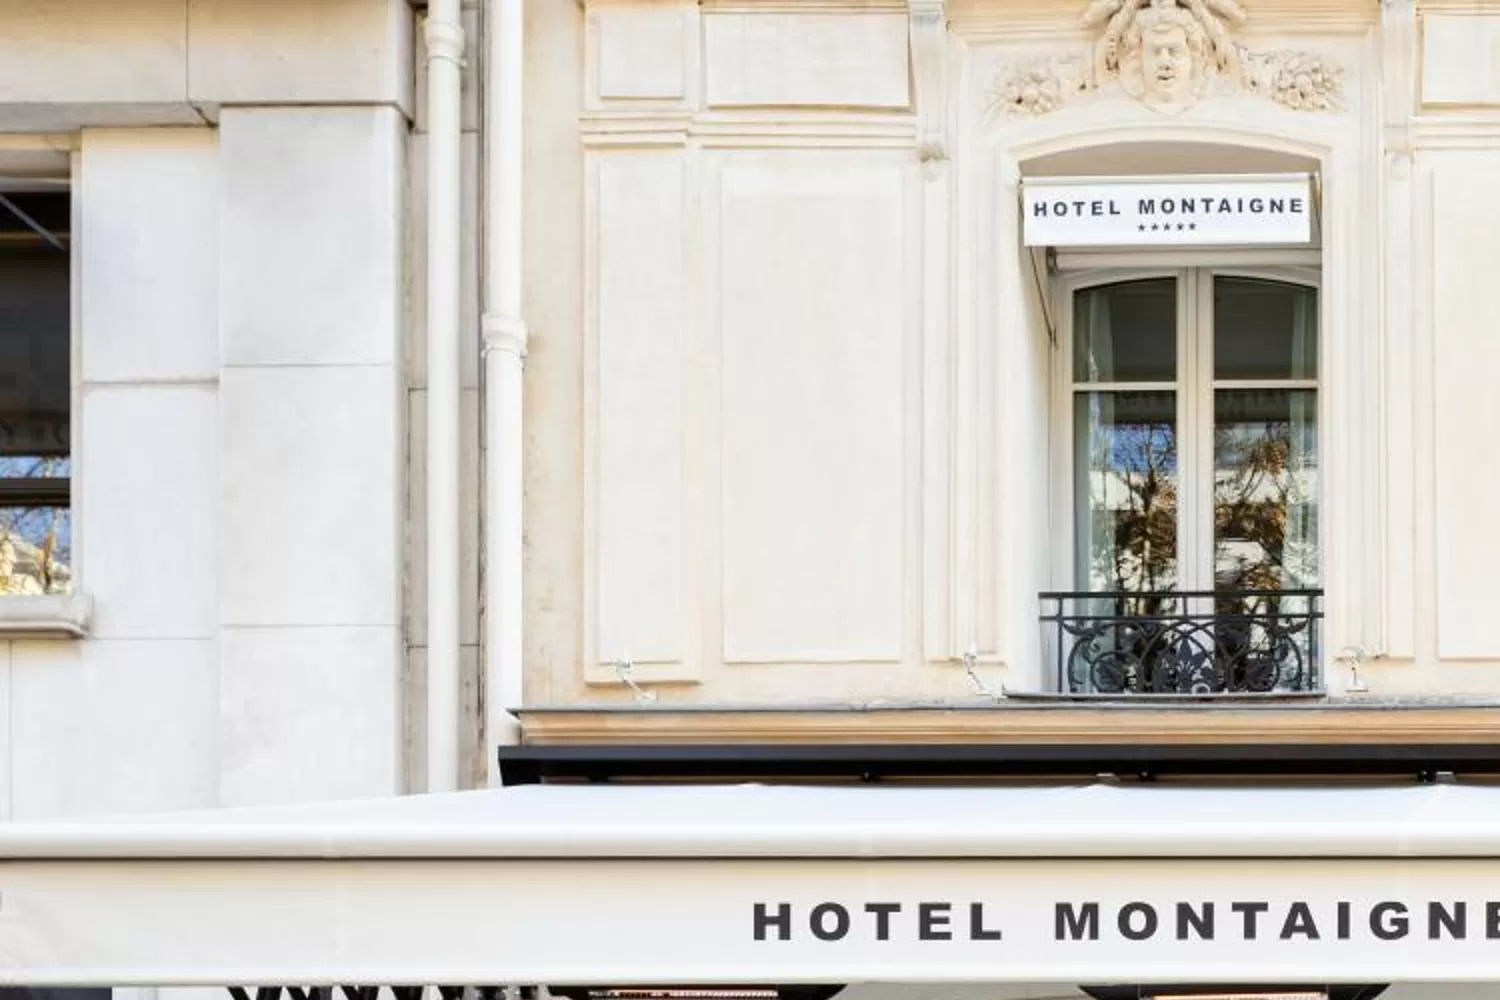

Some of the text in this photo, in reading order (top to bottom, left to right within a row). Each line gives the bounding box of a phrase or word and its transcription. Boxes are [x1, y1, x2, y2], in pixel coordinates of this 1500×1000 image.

[1033, 197, 1304, 217] HOTEL MONTAIGNE
[753, 901, 1002, 942] HOTEL
